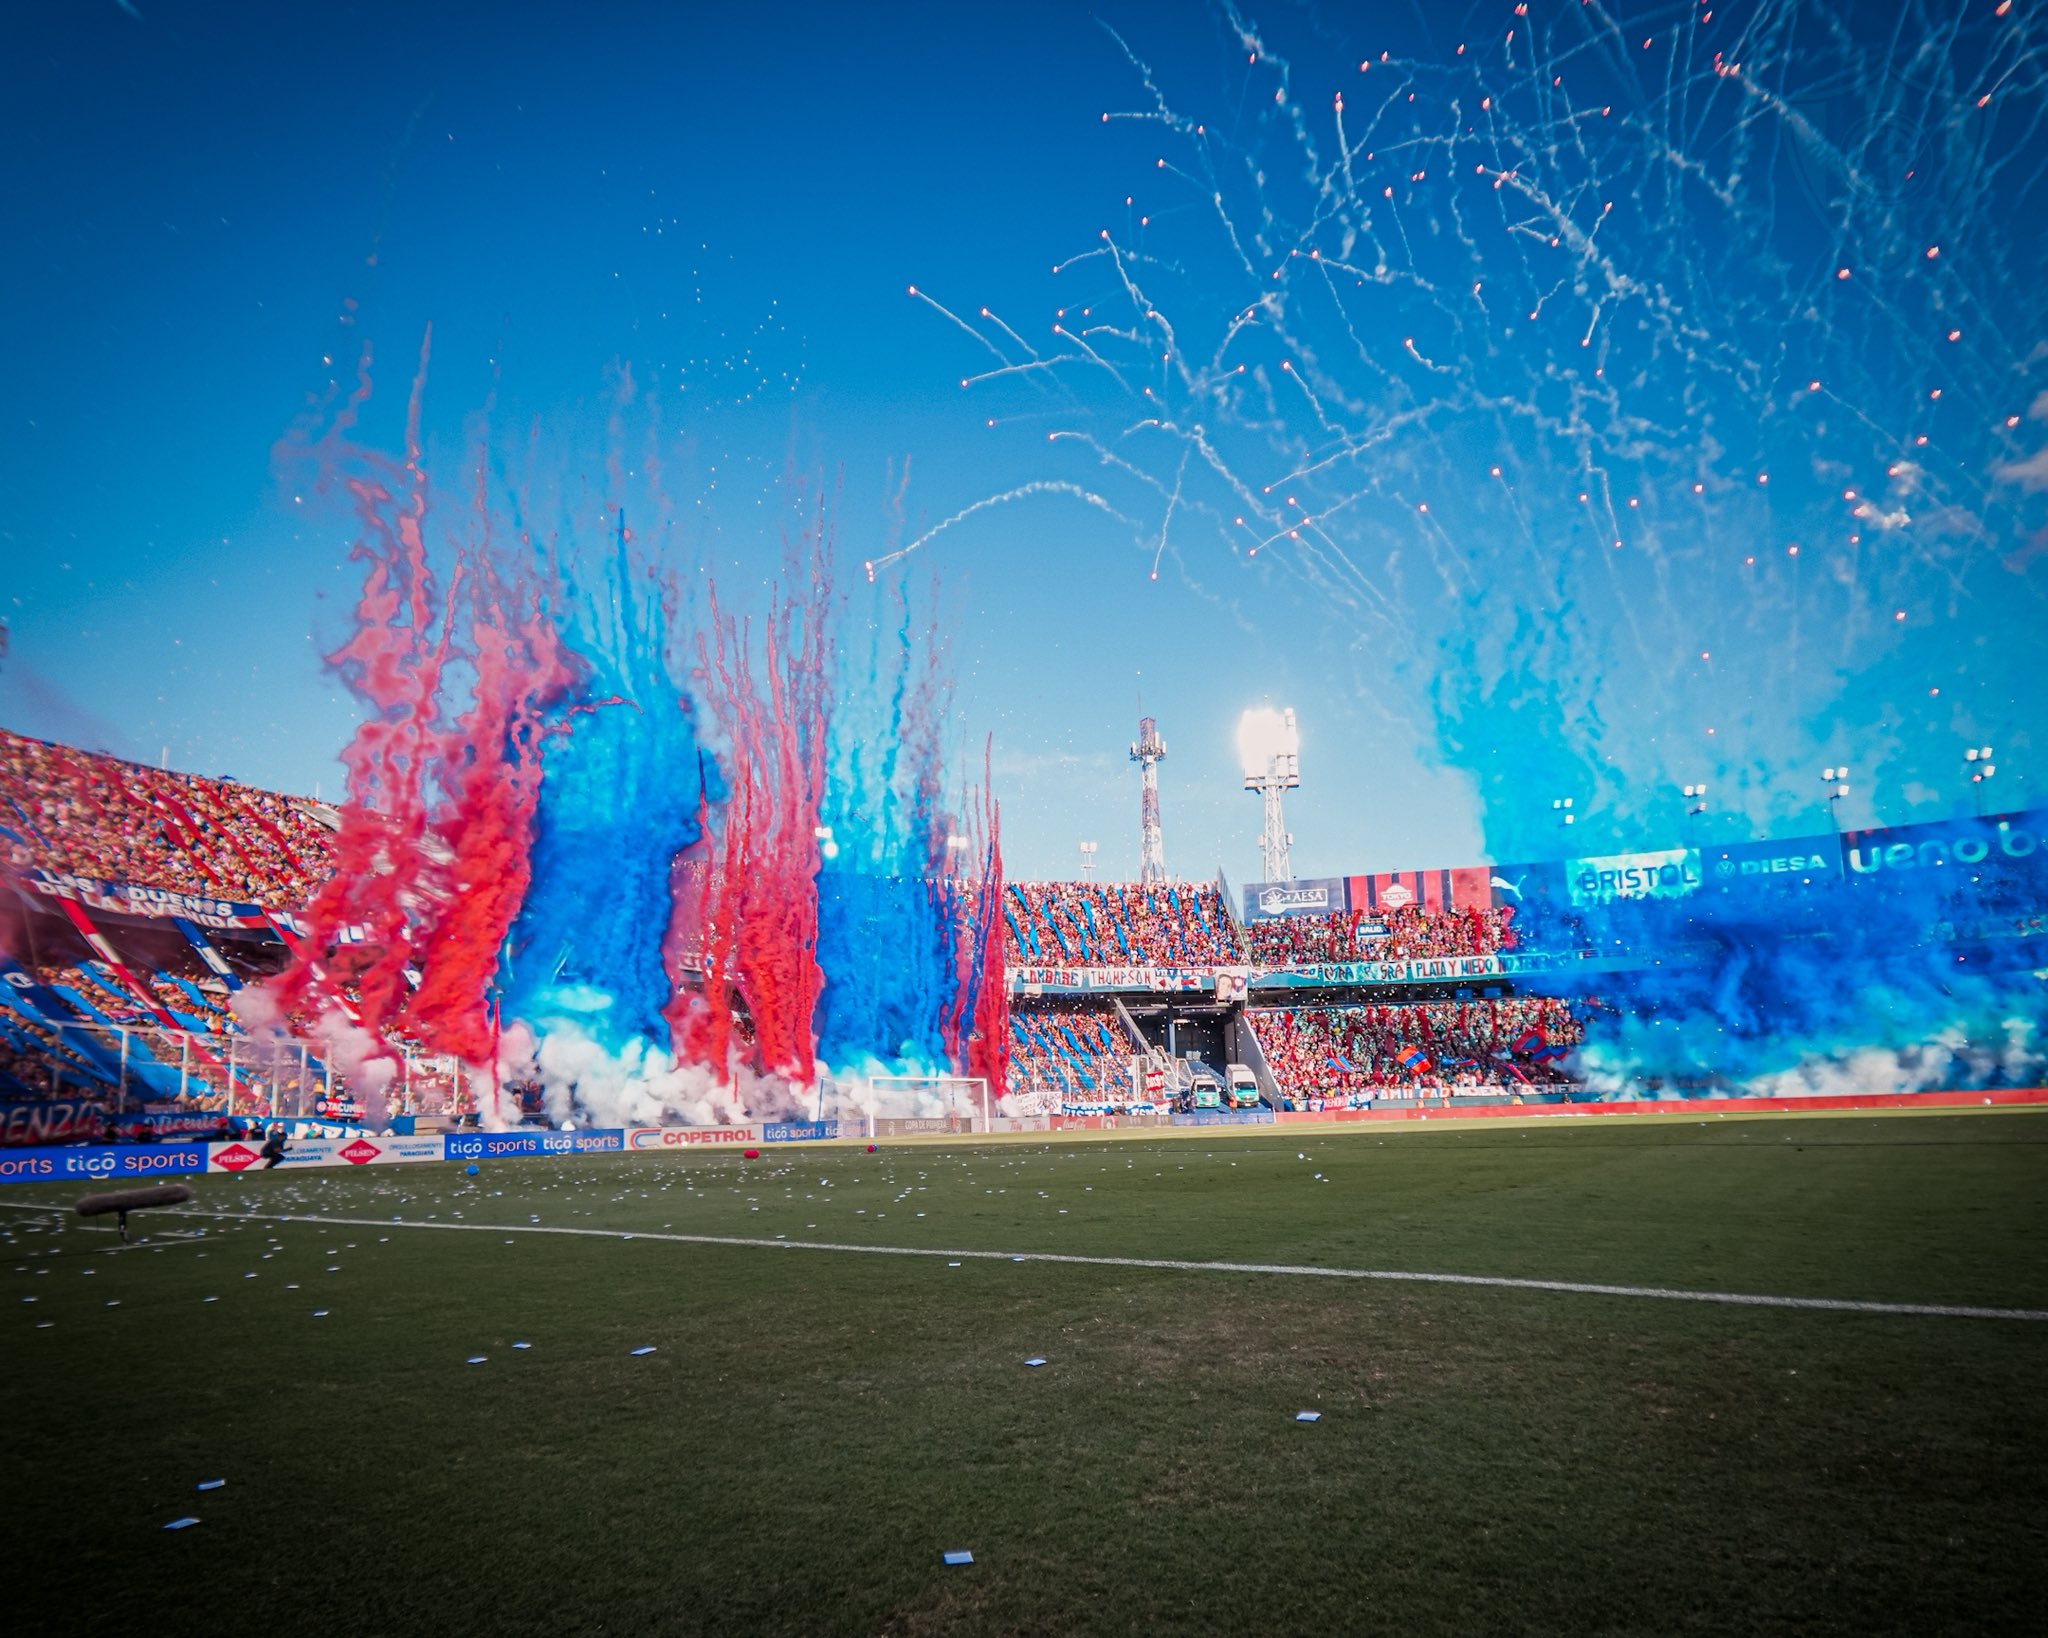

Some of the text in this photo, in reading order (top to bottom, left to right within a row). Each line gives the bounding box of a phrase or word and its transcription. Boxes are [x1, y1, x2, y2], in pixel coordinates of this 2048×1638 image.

[1849, 837, 1988, 873] ueno
[1740, 855, 1827, 875] DIESA
[1581, 864, 1697, 891] BRISTOL
[1292, 892, 1323, 903] AESA
[1382, 892, 1411, 901] TOKYO
[129, 901, 248, 929] AVENIDA
[1091, 970, 1151, 984] THOMPSON
[1416, 961, 1446, 977] PLATA
[1449, 960, 1456, 975] Y
[1460, 958, 1493, 975] MIEDO
[487, 1139, 536, 1154] sports
[575, 1135, 619, 1150] sports
[663, 1130, 756, 1145] COPETROL
[124, 1153, 198, 1173] sports
[218, 1154, 254, 1163] PILSEN
[345, 1149, 376, 1158] PILSEN
